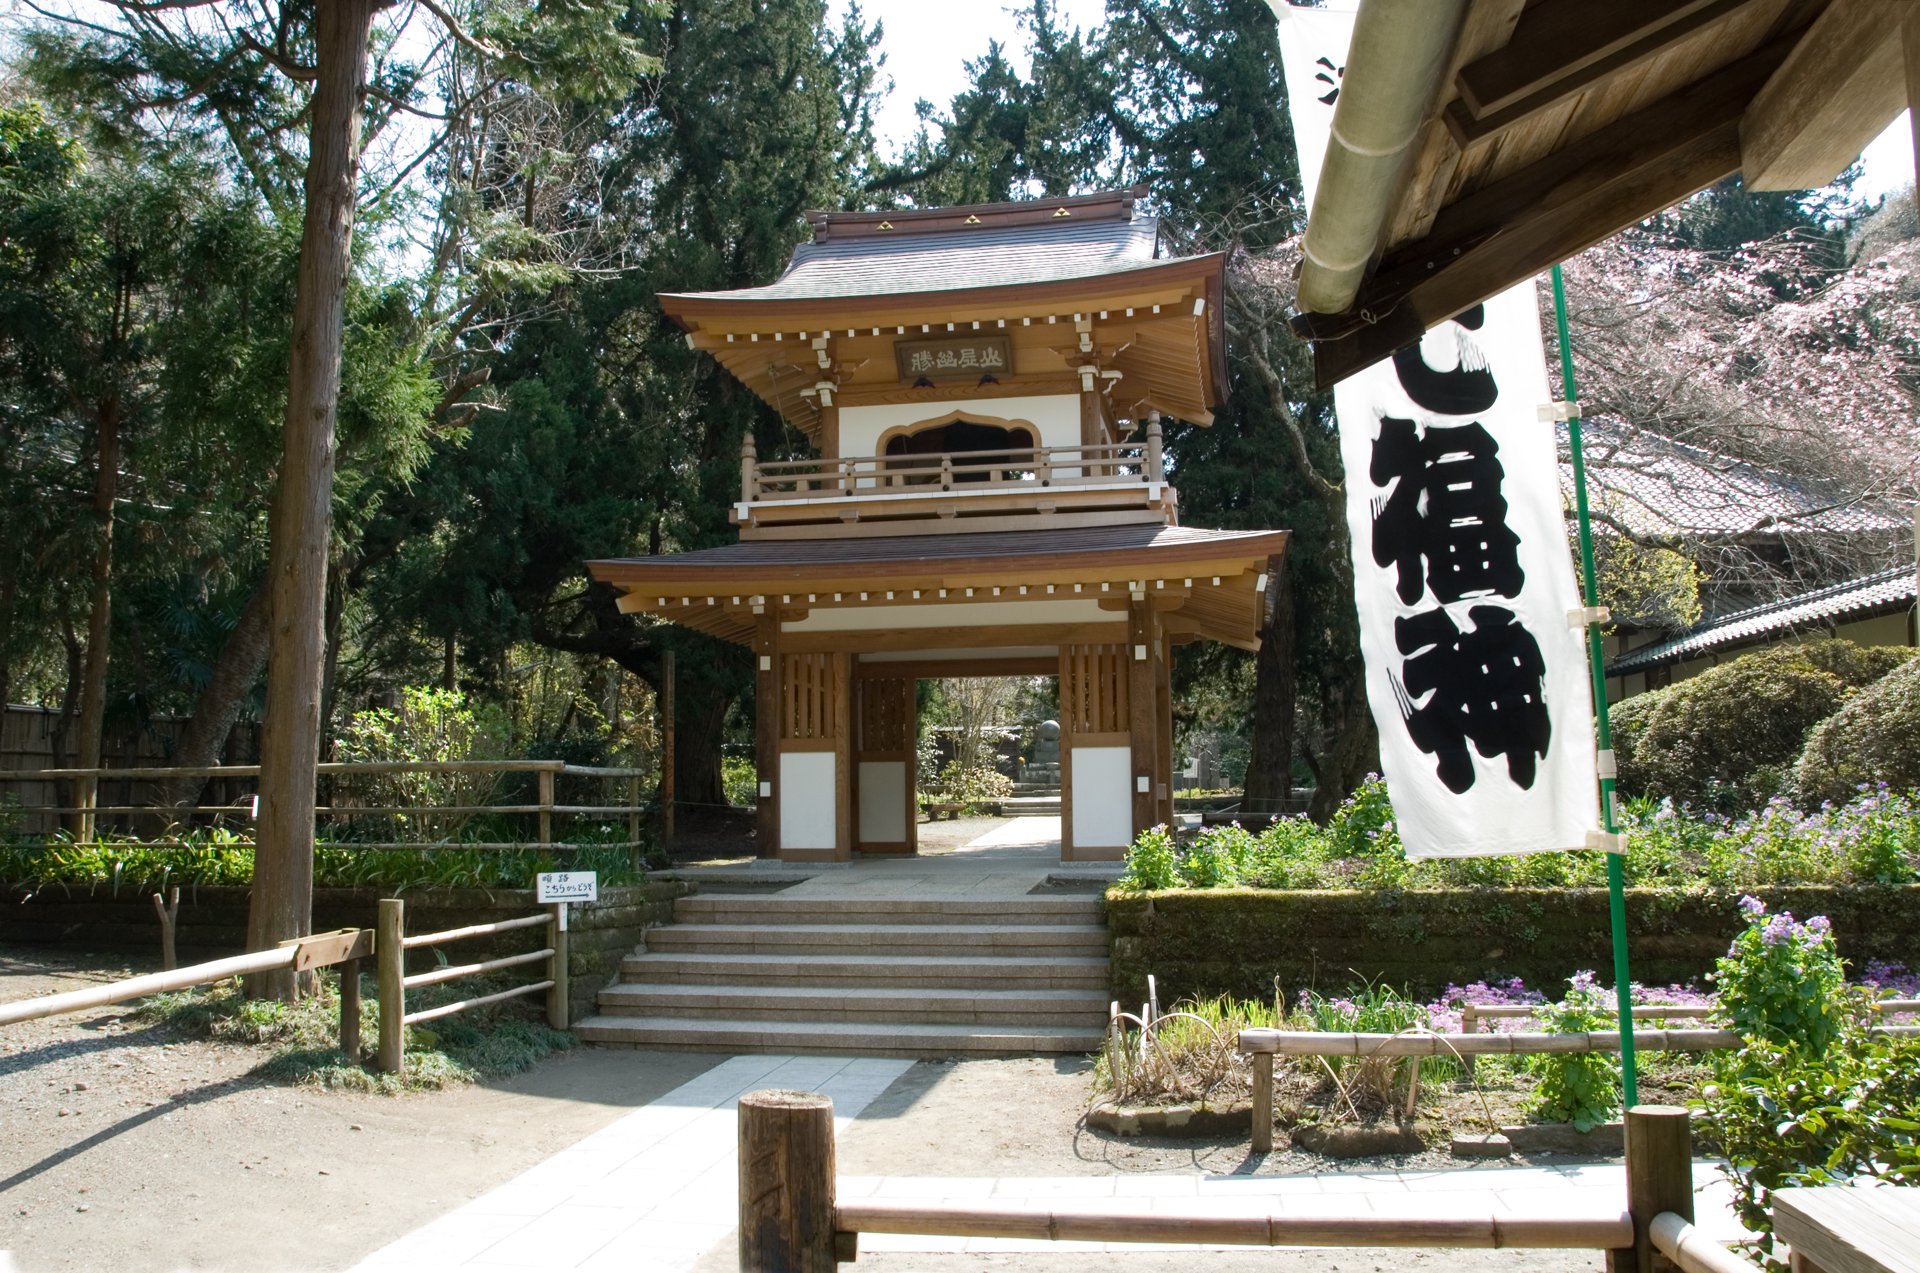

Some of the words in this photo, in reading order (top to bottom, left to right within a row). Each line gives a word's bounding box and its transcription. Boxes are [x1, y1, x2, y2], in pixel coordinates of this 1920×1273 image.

[545, 881, 595, 894] こちらからどうぞ
